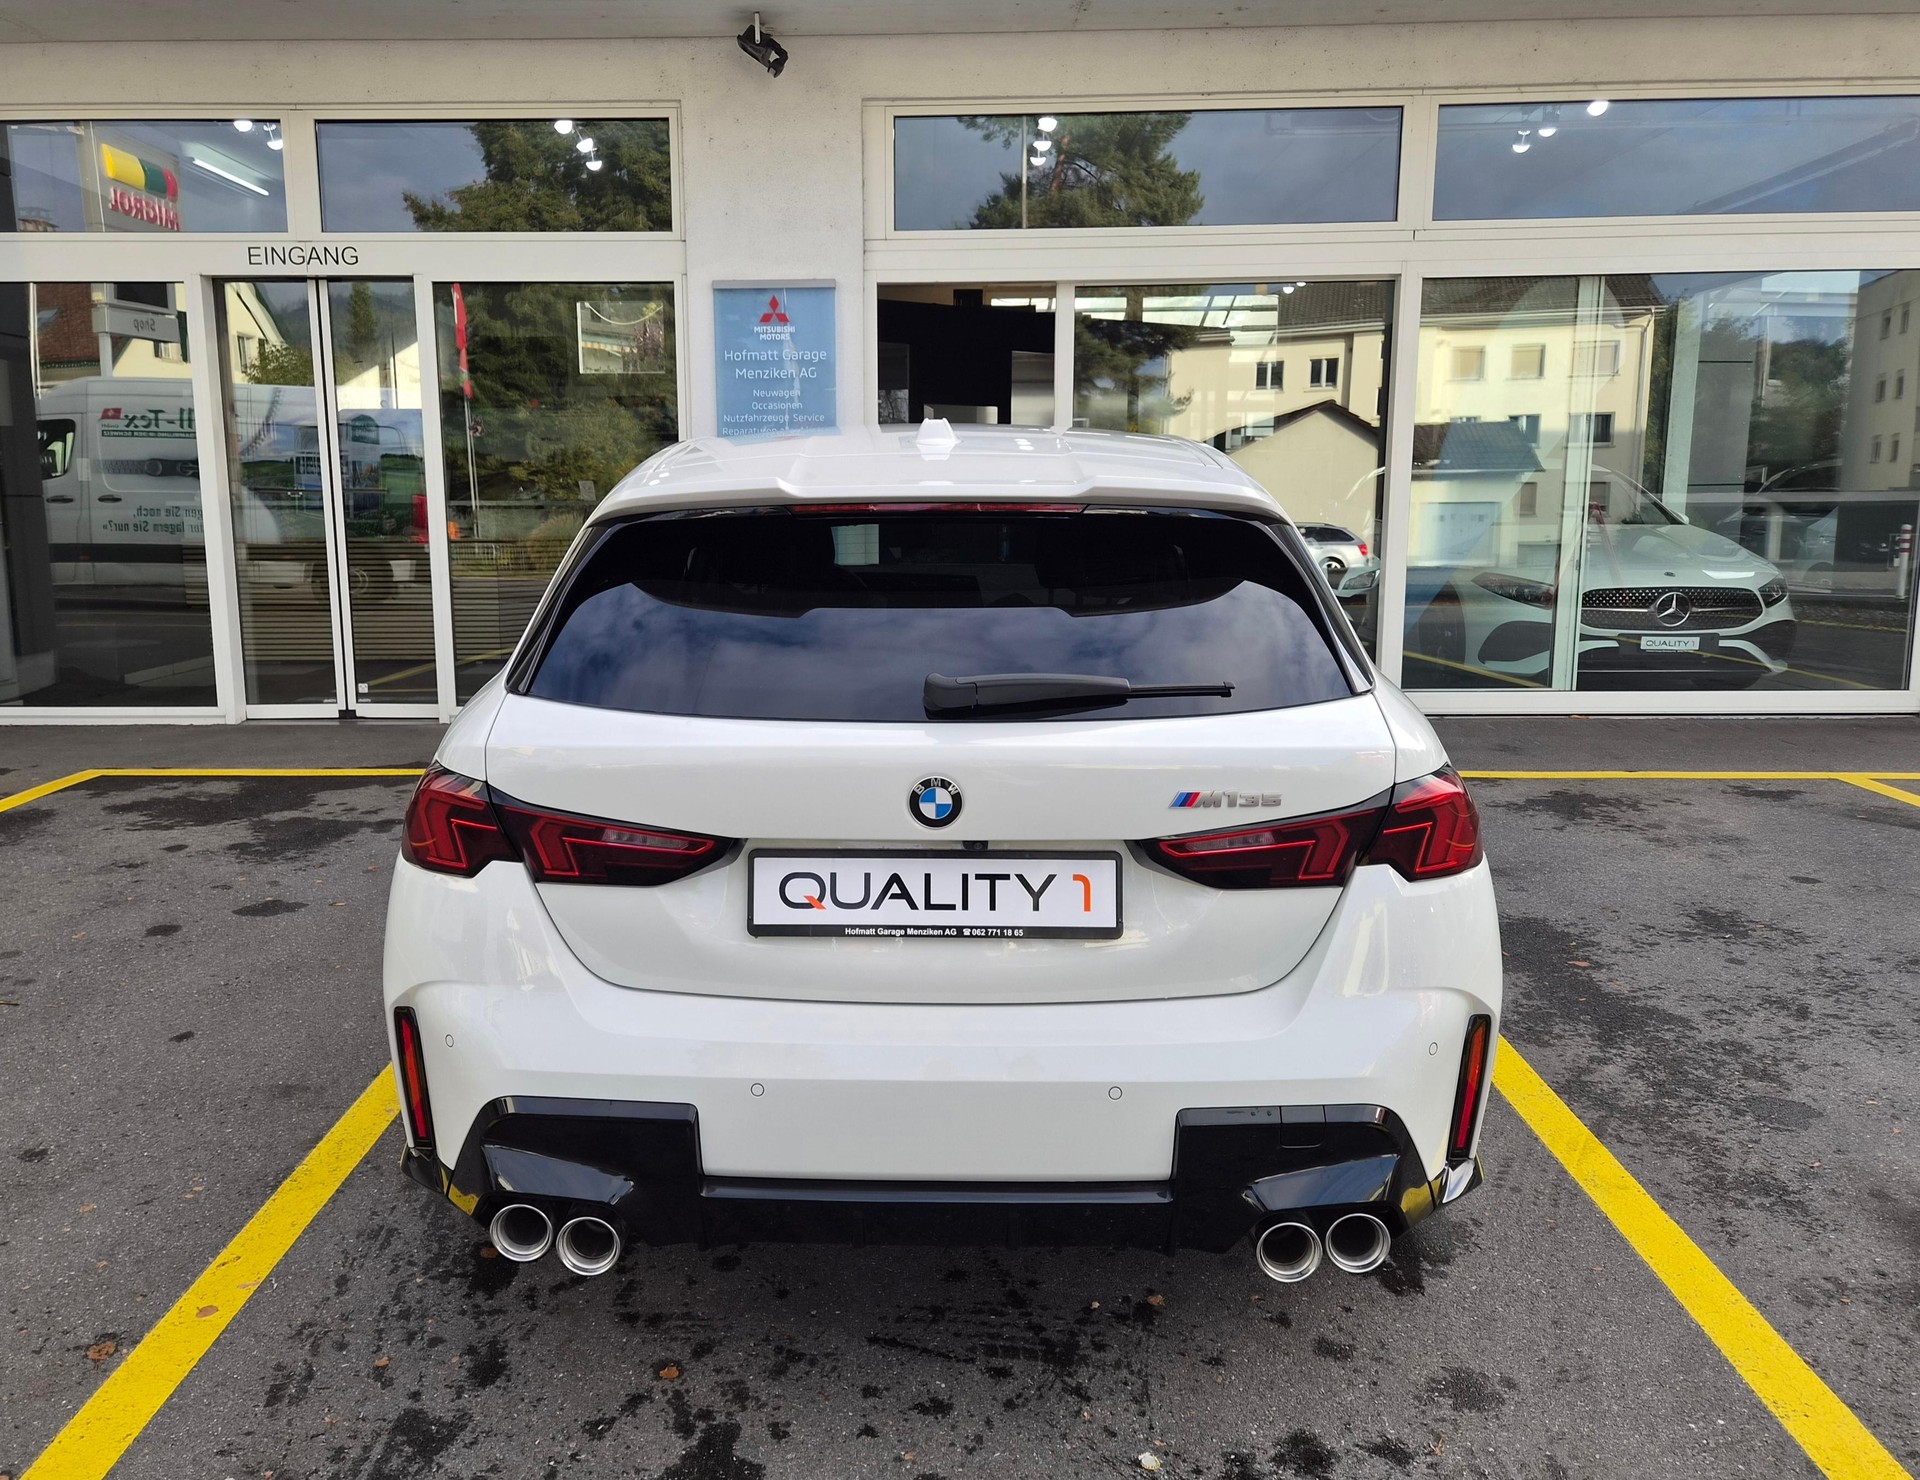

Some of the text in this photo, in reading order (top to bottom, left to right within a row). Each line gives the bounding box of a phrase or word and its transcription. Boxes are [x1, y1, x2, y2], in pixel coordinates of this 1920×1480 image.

[247, 246, 359, 266] EINGANG
[753, 326, 796, 334] MITSUBISHI
[759, 333, 790, 341] MOTORS
[724, 349, 827, 363] Hofmatt Garage
[735, 367, 817, 379] Menziken AG
[752, 389, 801, 399] Neuwagen
[751, 402, 803, 410] Occasionen
[723, 413, 825, 424] Nutzfahrzeuge Service
[914, 777, 959, 796] BMW
[1190, 790, 1282, 808] M135
[778, 871, 1091, 912] QUALITY 1
[845, 927, 1024, 937] Hofmatt Garage Menziken AG 062 771 18 65
